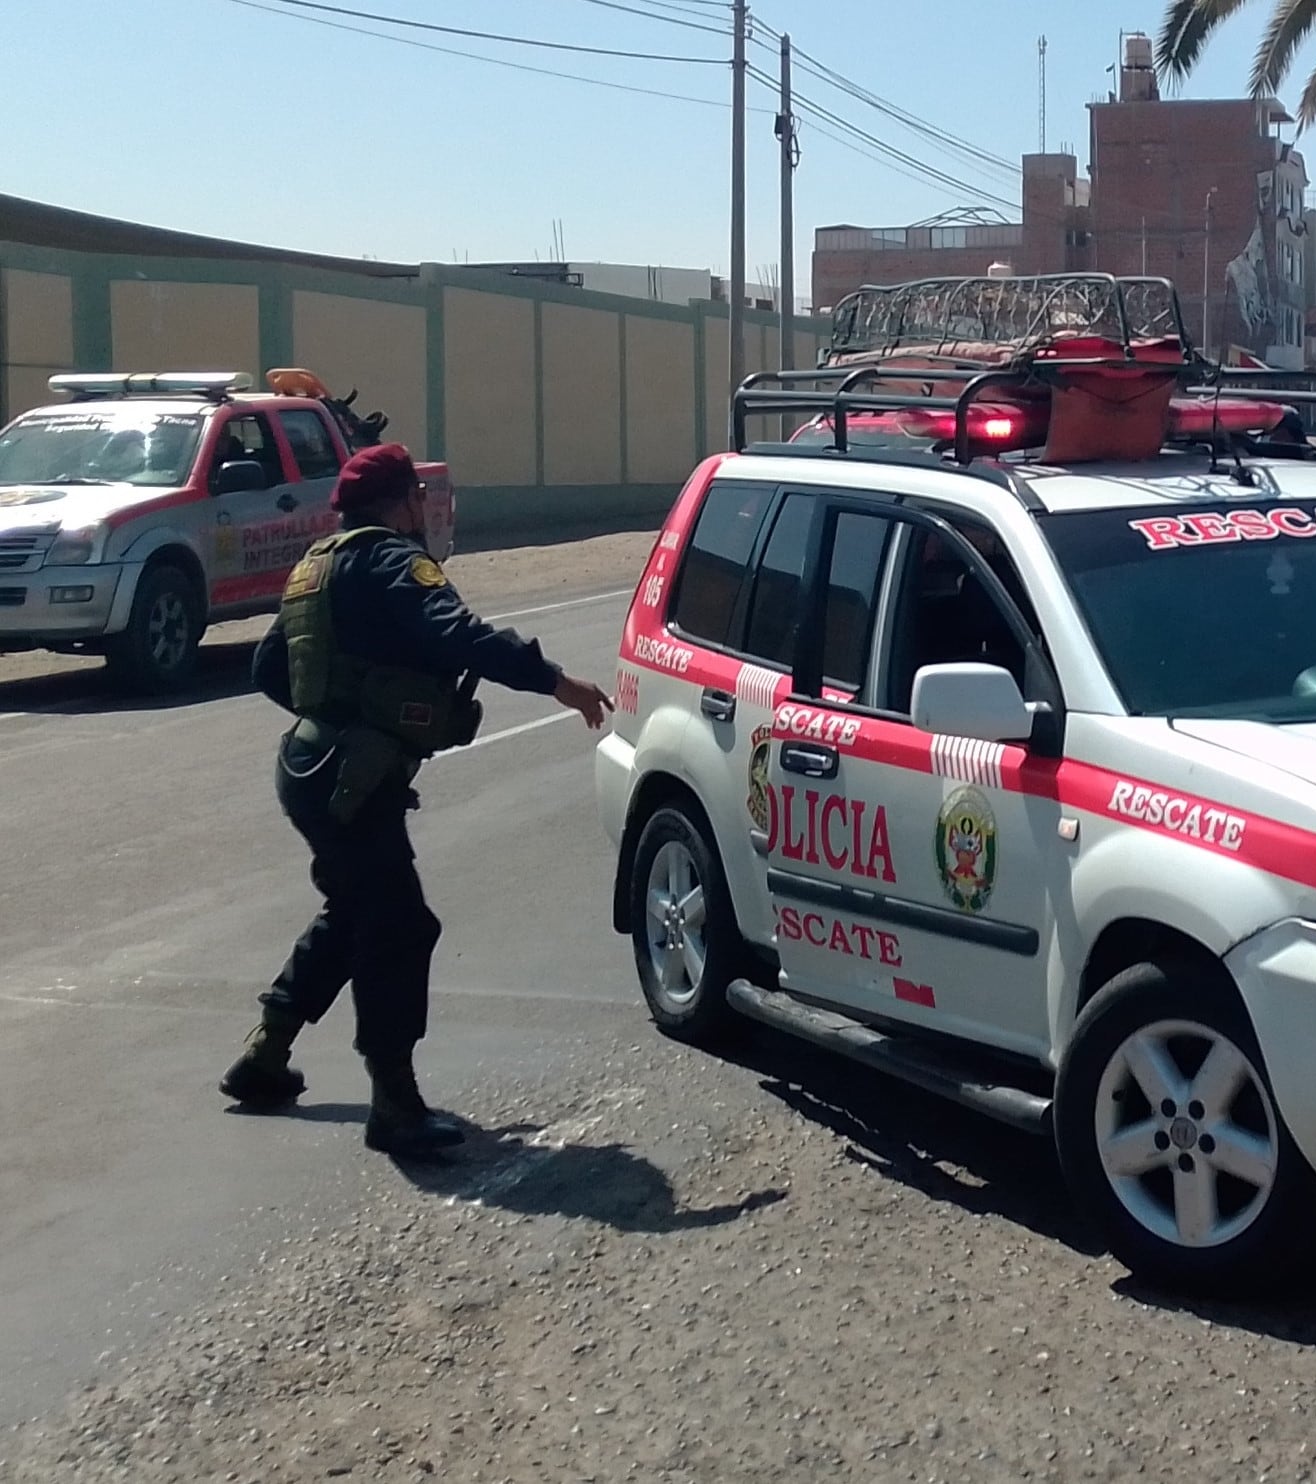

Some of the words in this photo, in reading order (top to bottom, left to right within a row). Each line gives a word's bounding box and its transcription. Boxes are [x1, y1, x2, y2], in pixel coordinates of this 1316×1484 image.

[243, 541, 310, 571] INTEGR
[634, 634, 694, 673] RESCATE
[774, 701, 861, 746] SCATE
[1107, 780, 1246, 851] RESCATE
[772, 904, 903, 967] SCATE
